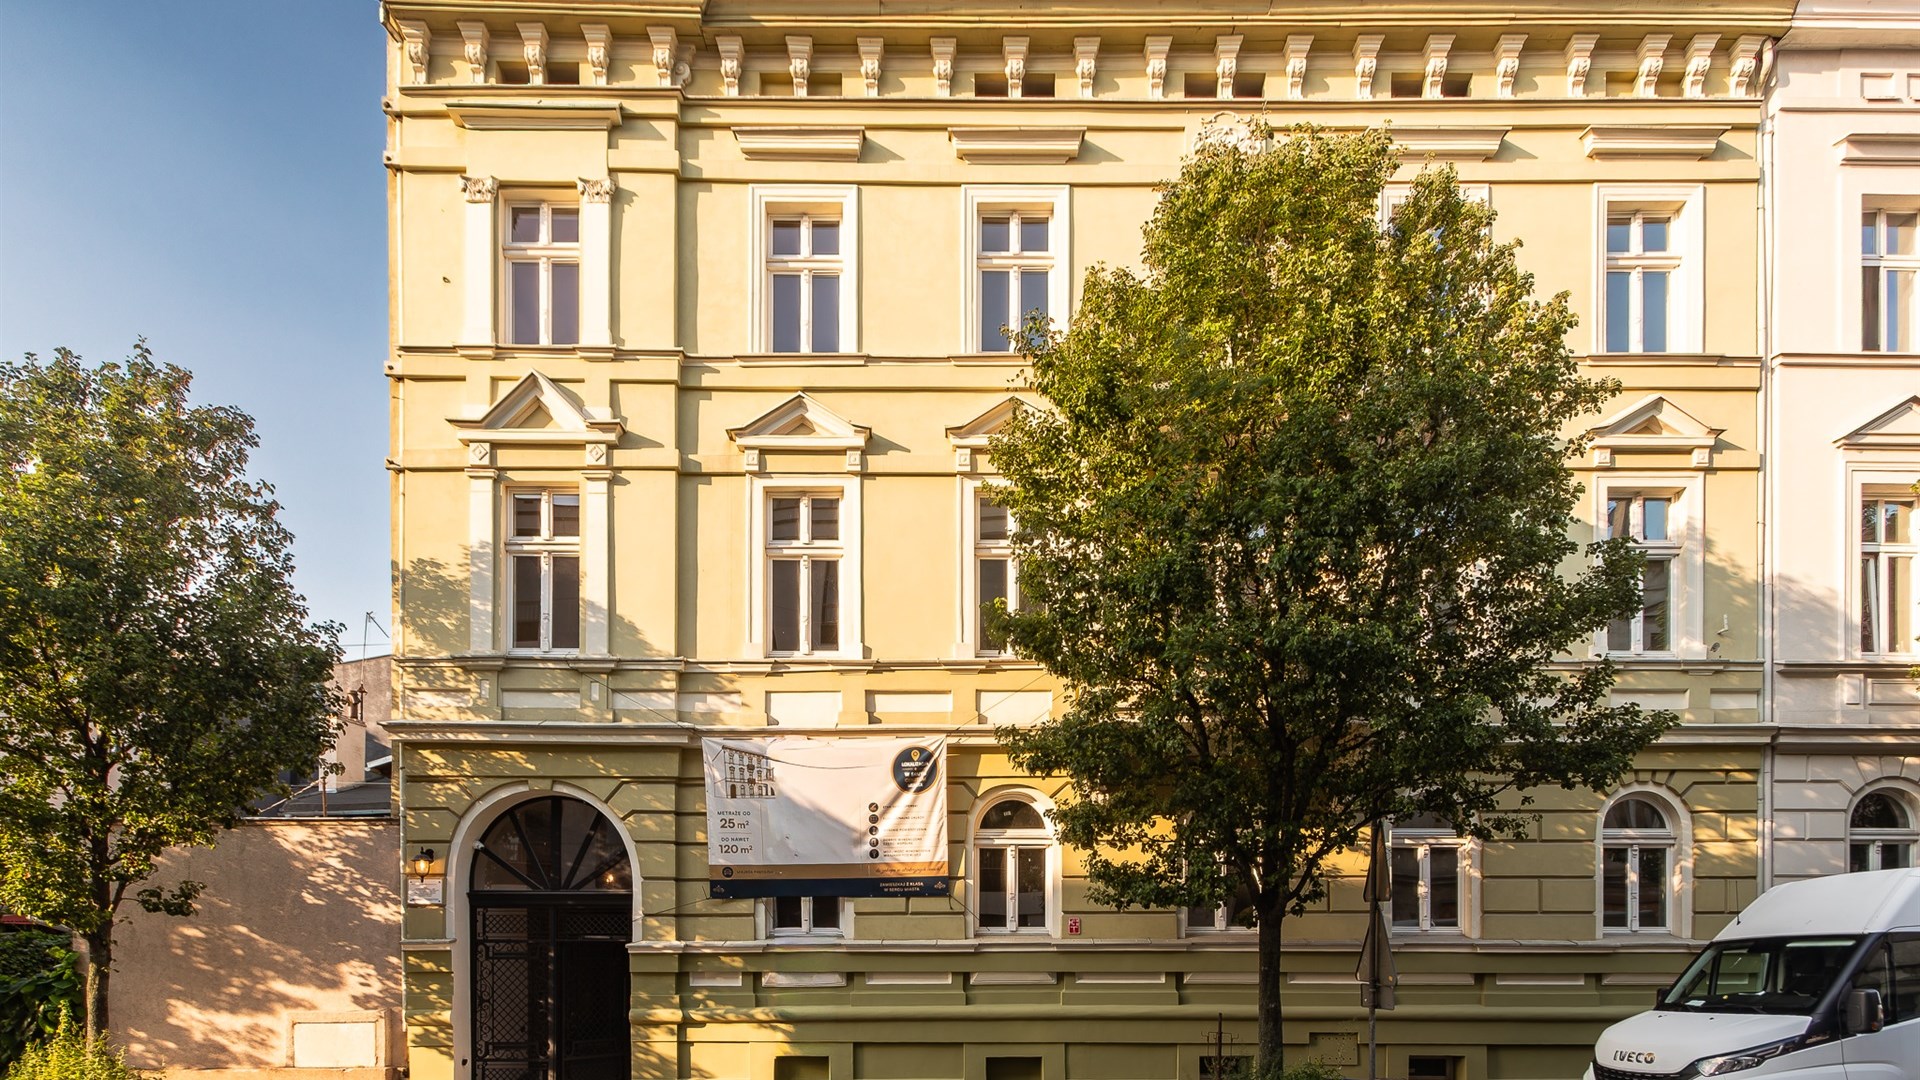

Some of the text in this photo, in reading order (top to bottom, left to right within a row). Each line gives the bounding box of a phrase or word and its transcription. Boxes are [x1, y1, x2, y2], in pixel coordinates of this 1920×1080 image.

[720, 818, 735, 829] 25
[719, 844, 739, 854] 120
[1613, 1050, 1656, 1064] IVECO
